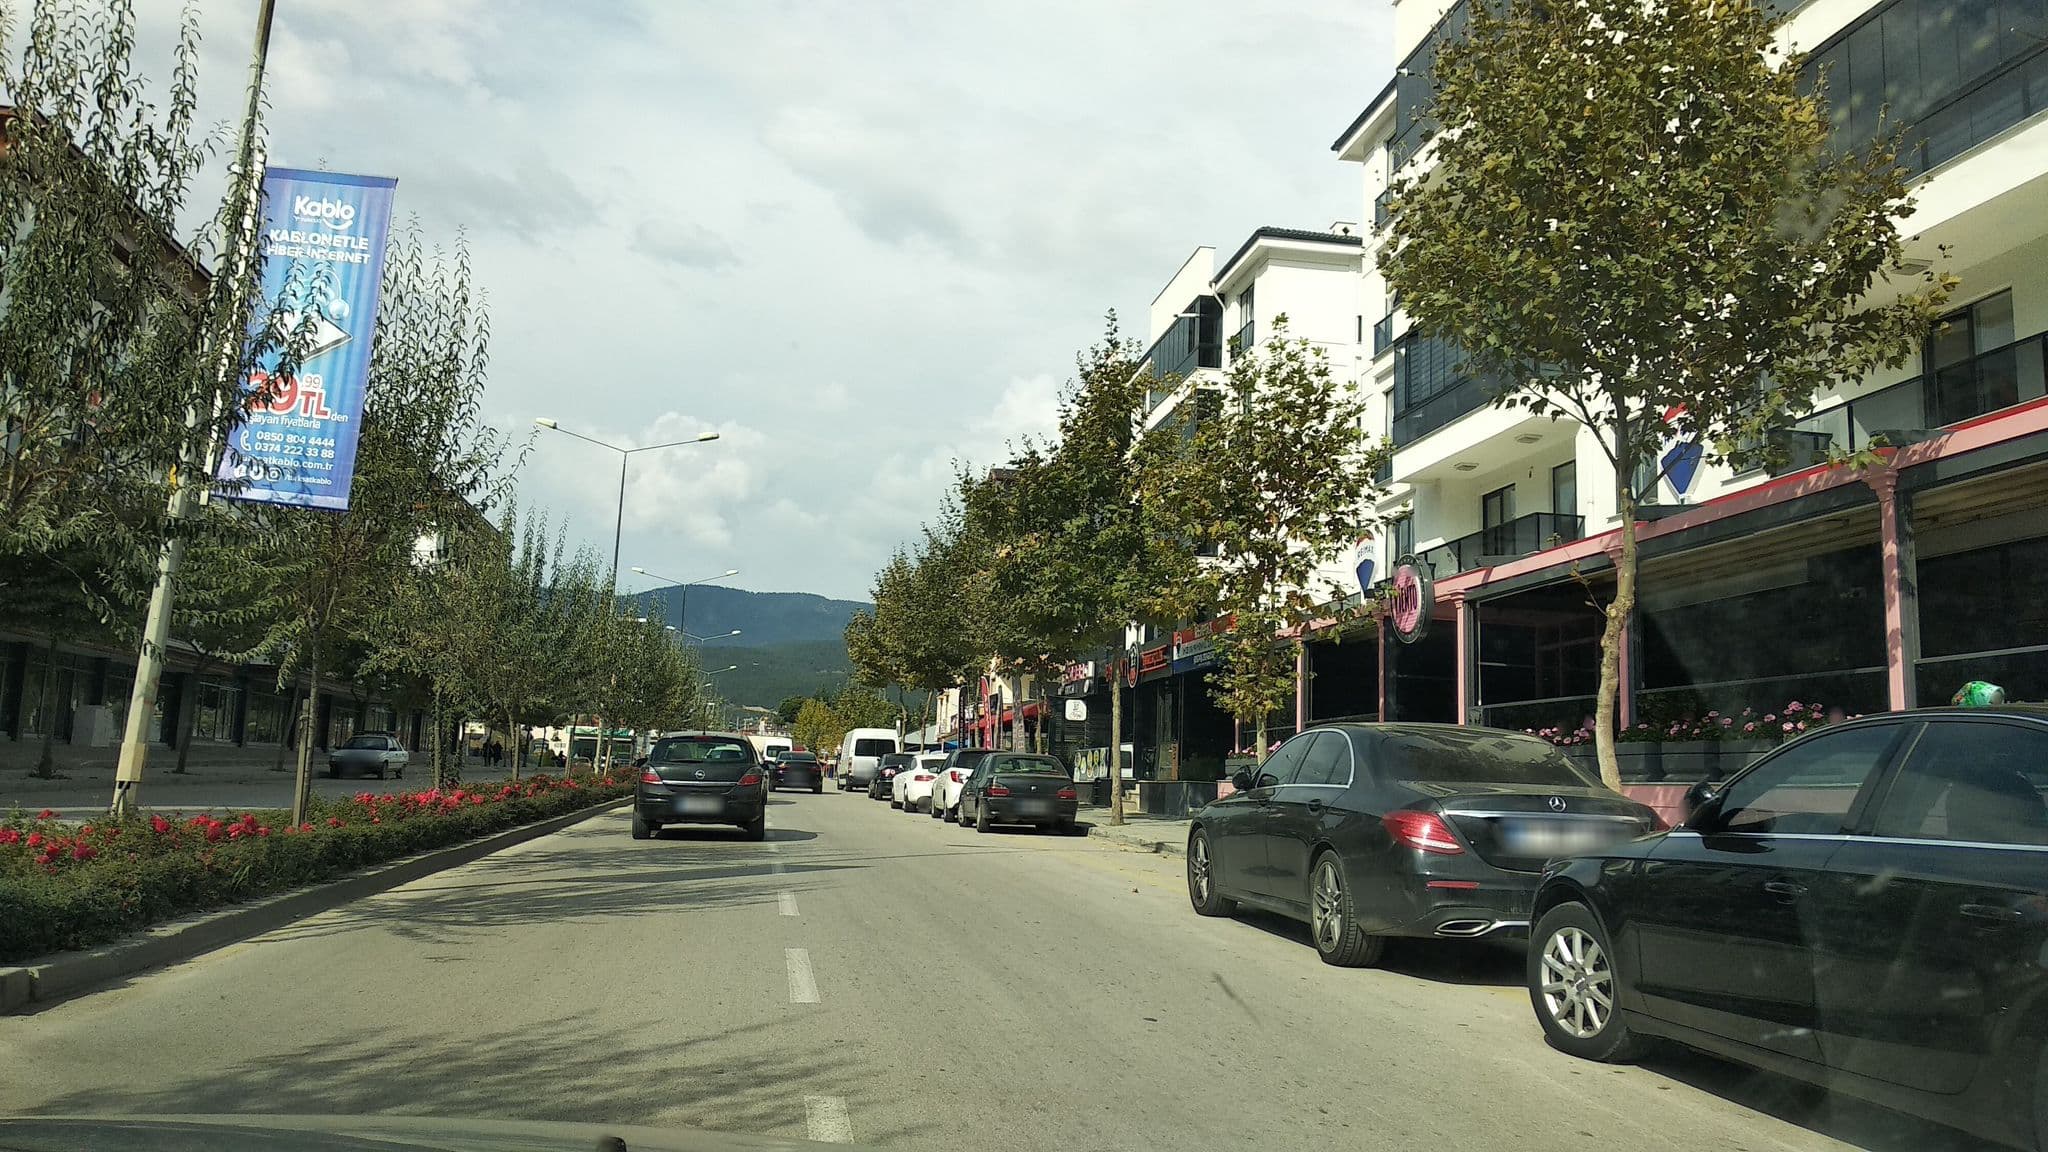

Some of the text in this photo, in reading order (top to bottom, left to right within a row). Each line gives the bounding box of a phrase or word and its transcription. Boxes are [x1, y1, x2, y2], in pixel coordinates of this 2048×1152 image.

[294, 195, 355, 219] Kablo
[269, 229, 370, 251] KABLONETLE
[304, 375, 321, 388] 99
[300, 389, 349, 423] TL den
[256, 431, 335, 448] 0850 804 4444
[254, 441, 335, 459] 0374 222 33 88
